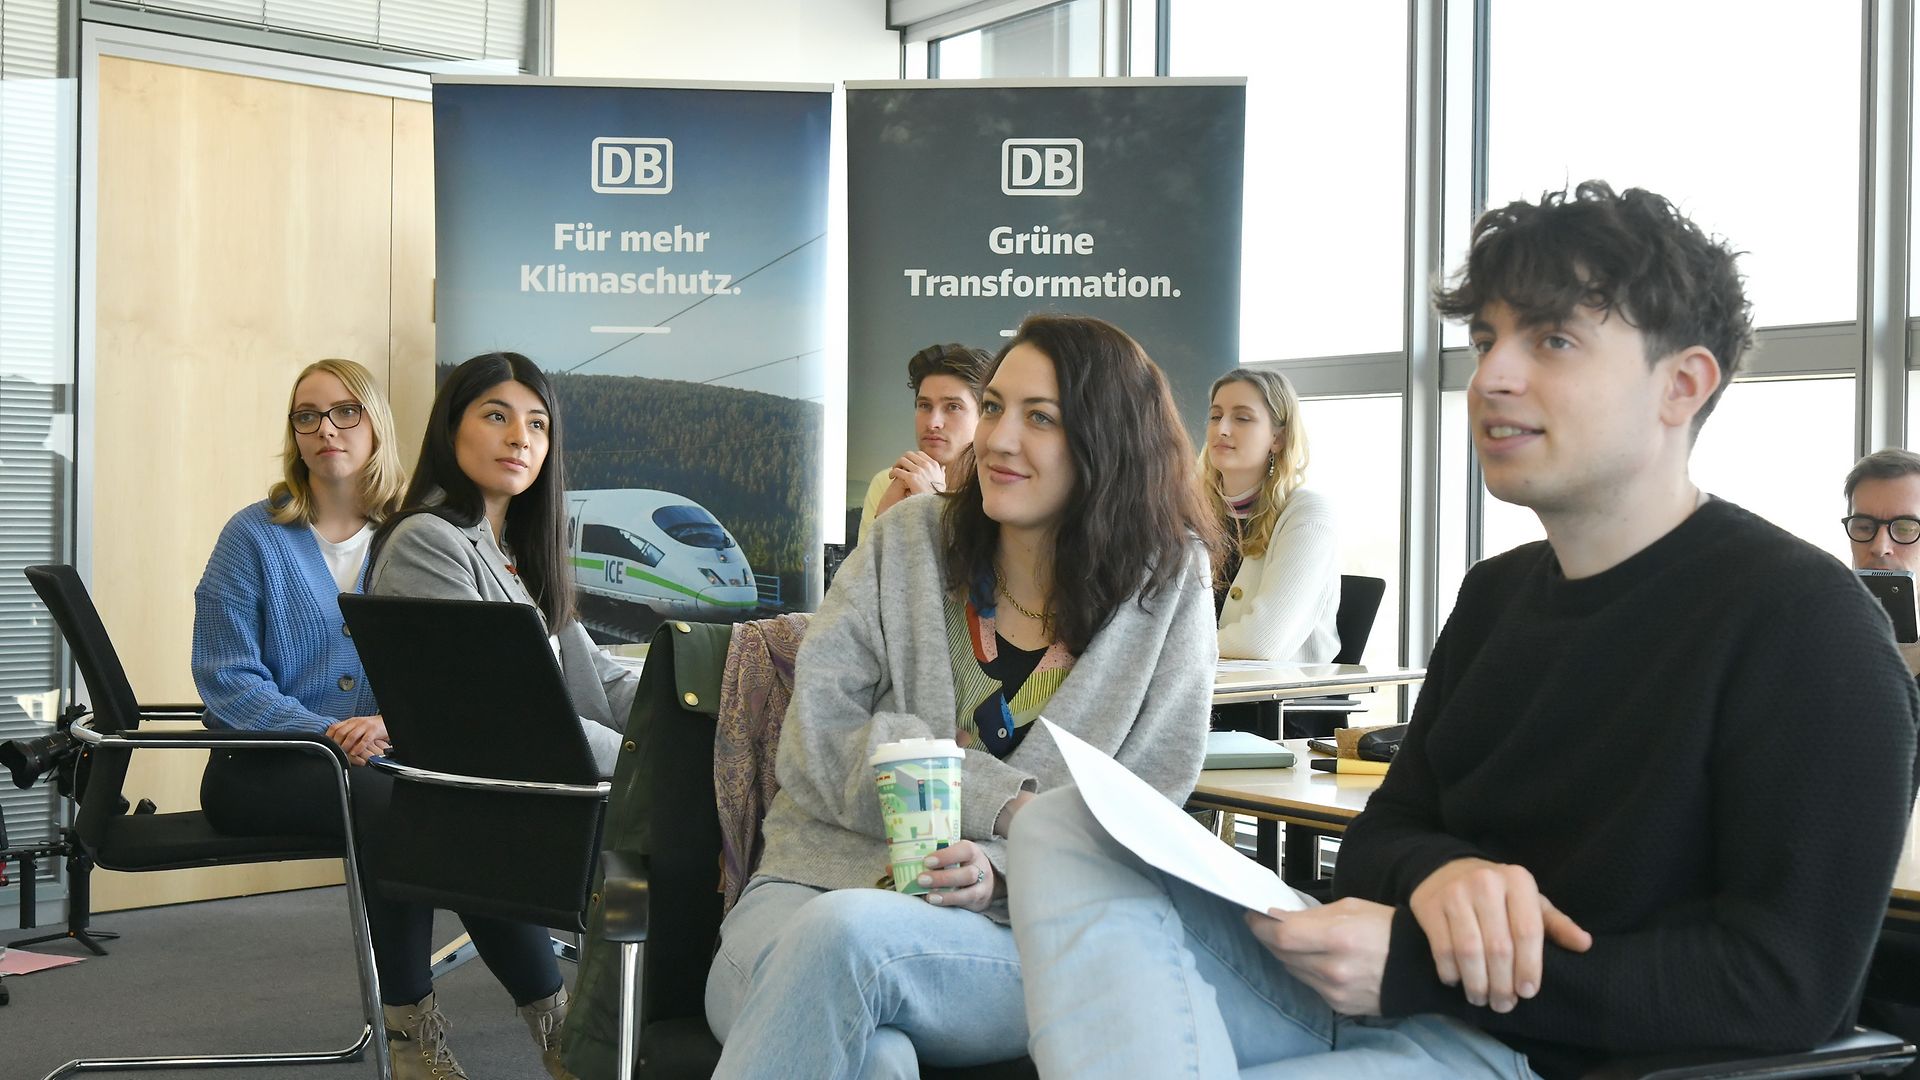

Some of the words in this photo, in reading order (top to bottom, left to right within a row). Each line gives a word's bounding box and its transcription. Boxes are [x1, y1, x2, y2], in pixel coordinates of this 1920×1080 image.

[603, 146, 664, 185] DB
[1012, 147, 1074, 187] DB
[554, 222, 611, 251] Für
[620, 224, 710, 253] mehr
[988, 225, 1094, 255] Grüne
[520, 264, 742, 295] Klimaschutz.
[904, 268, 1182, 298] Transformation.
[605, 560, 624, 584] ICE
